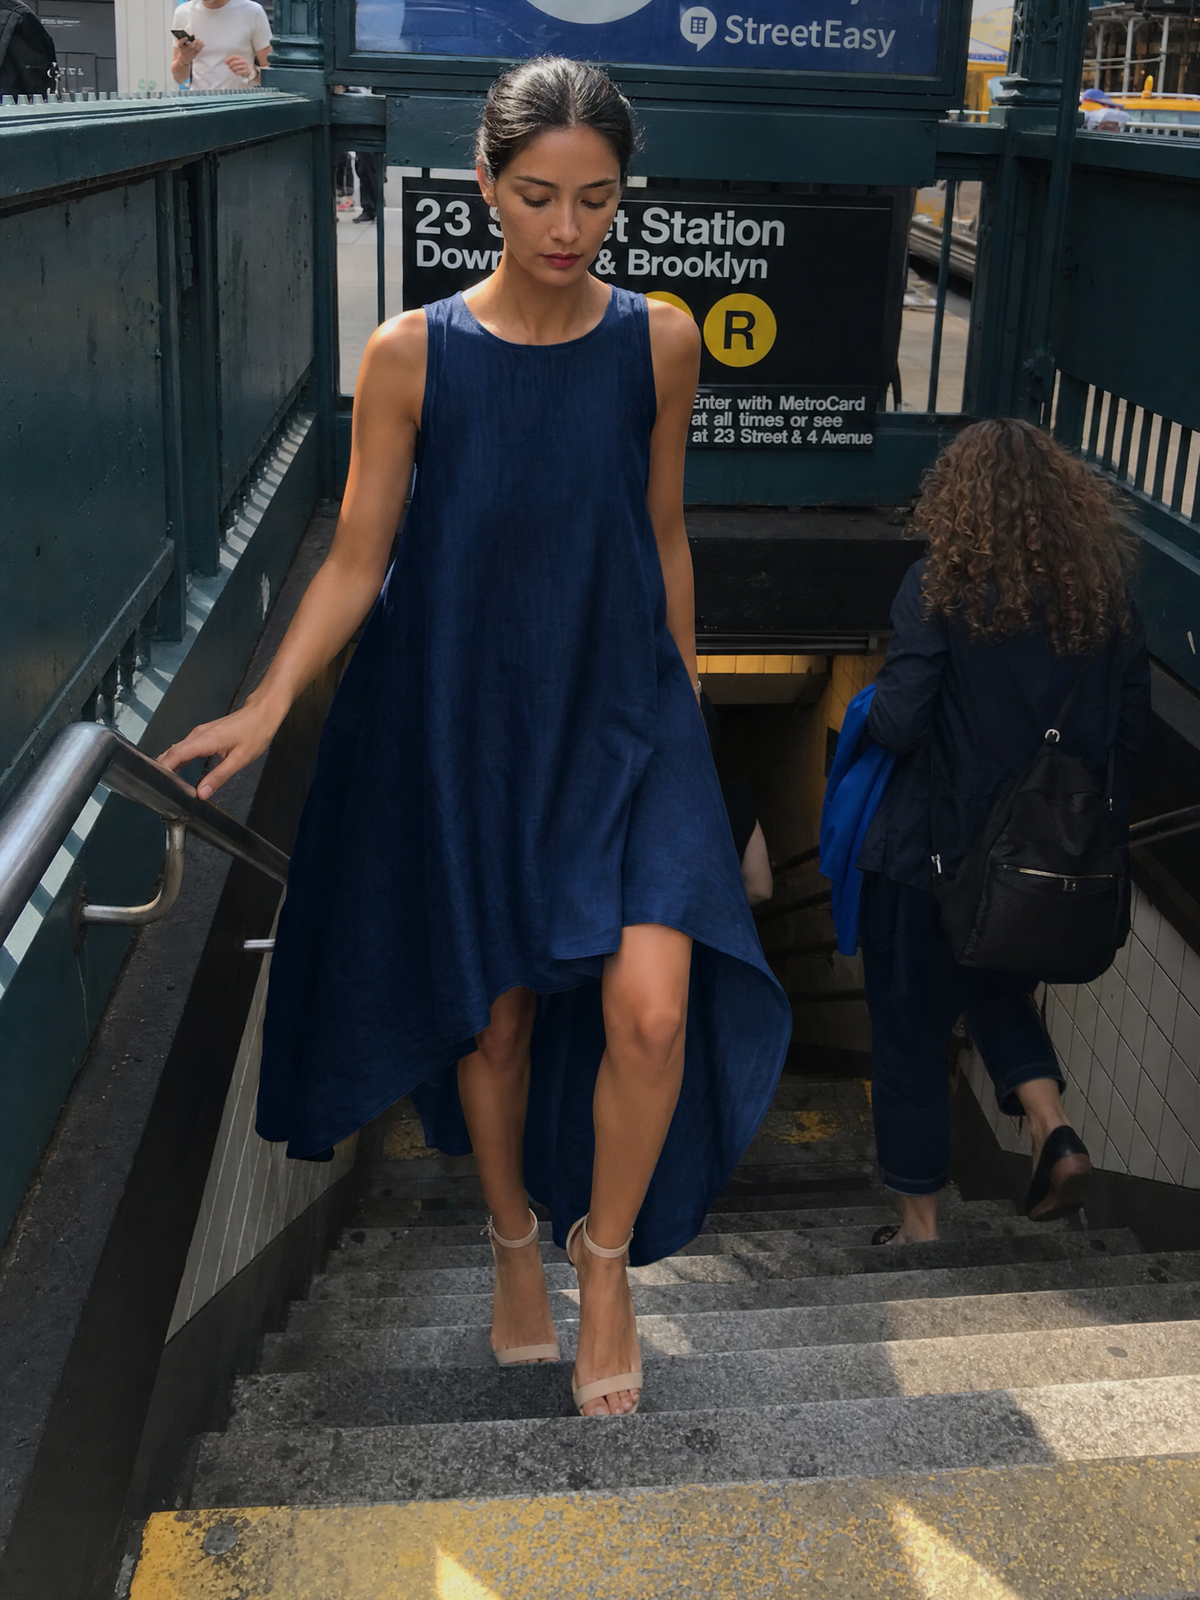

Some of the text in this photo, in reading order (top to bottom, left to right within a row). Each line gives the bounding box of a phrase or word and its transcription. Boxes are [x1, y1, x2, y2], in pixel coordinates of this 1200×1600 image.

[724, 14, 897, 59] StreetEasy
[415, 198, 472, 237] 23
[640, 206, 786, 247] Station
[594, 248, 617, 275] &
[627, 248, 768, 285] Brooklyn
[723, 310, 756, 350] R
[691, 412, 843, 428] at all times or see
[737, 395, 772, 411] with
[779, 395, 866, 412] MetroCard
[691, 428, 873, 445] at 23 Street & 4 Avenue
